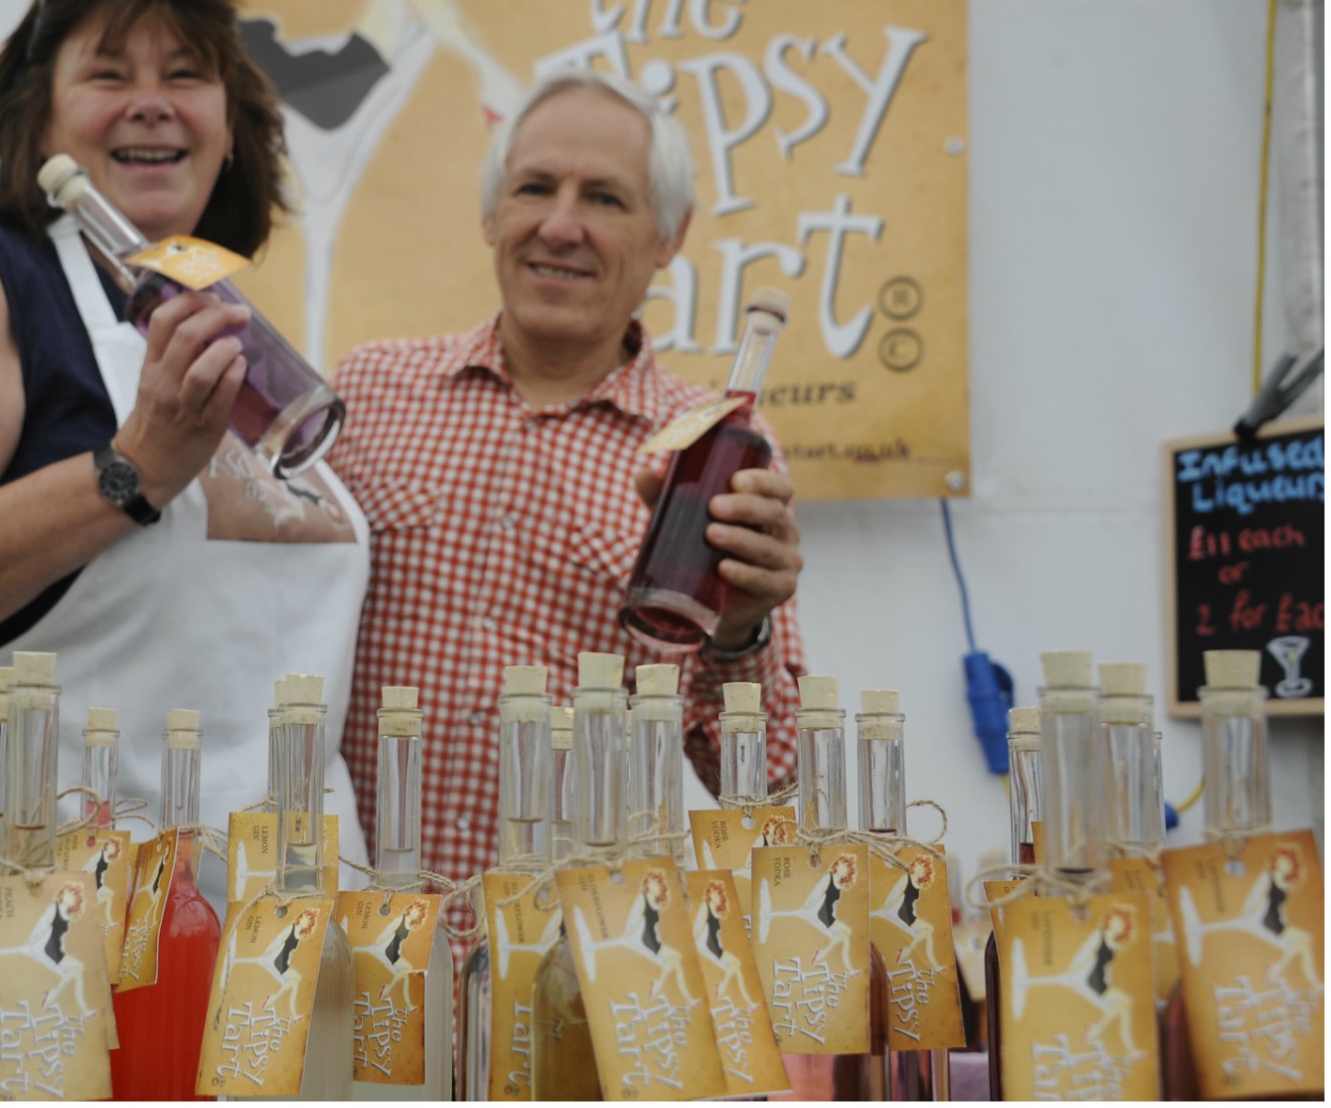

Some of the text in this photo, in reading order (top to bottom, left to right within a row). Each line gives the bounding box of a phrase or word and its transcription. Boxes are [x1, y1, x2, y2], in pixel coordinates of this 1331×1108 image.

[1178, 435, 1324, 482] Infused
[1189, 524, 1305, 560] £11 each
[1218, 561, 1250, 585] or
[1196, 589, 1267, 635] 2 for
[773, 956, 802, 1037] Tart
[795, 961, 830, 1045] Tipsy
[825, 971, 850, 1009] the
[216, 1001, 253, 1079] Tart
[241, 1005, 281, 1087] Tipsy
[268, 1017, 290, 1053] the
